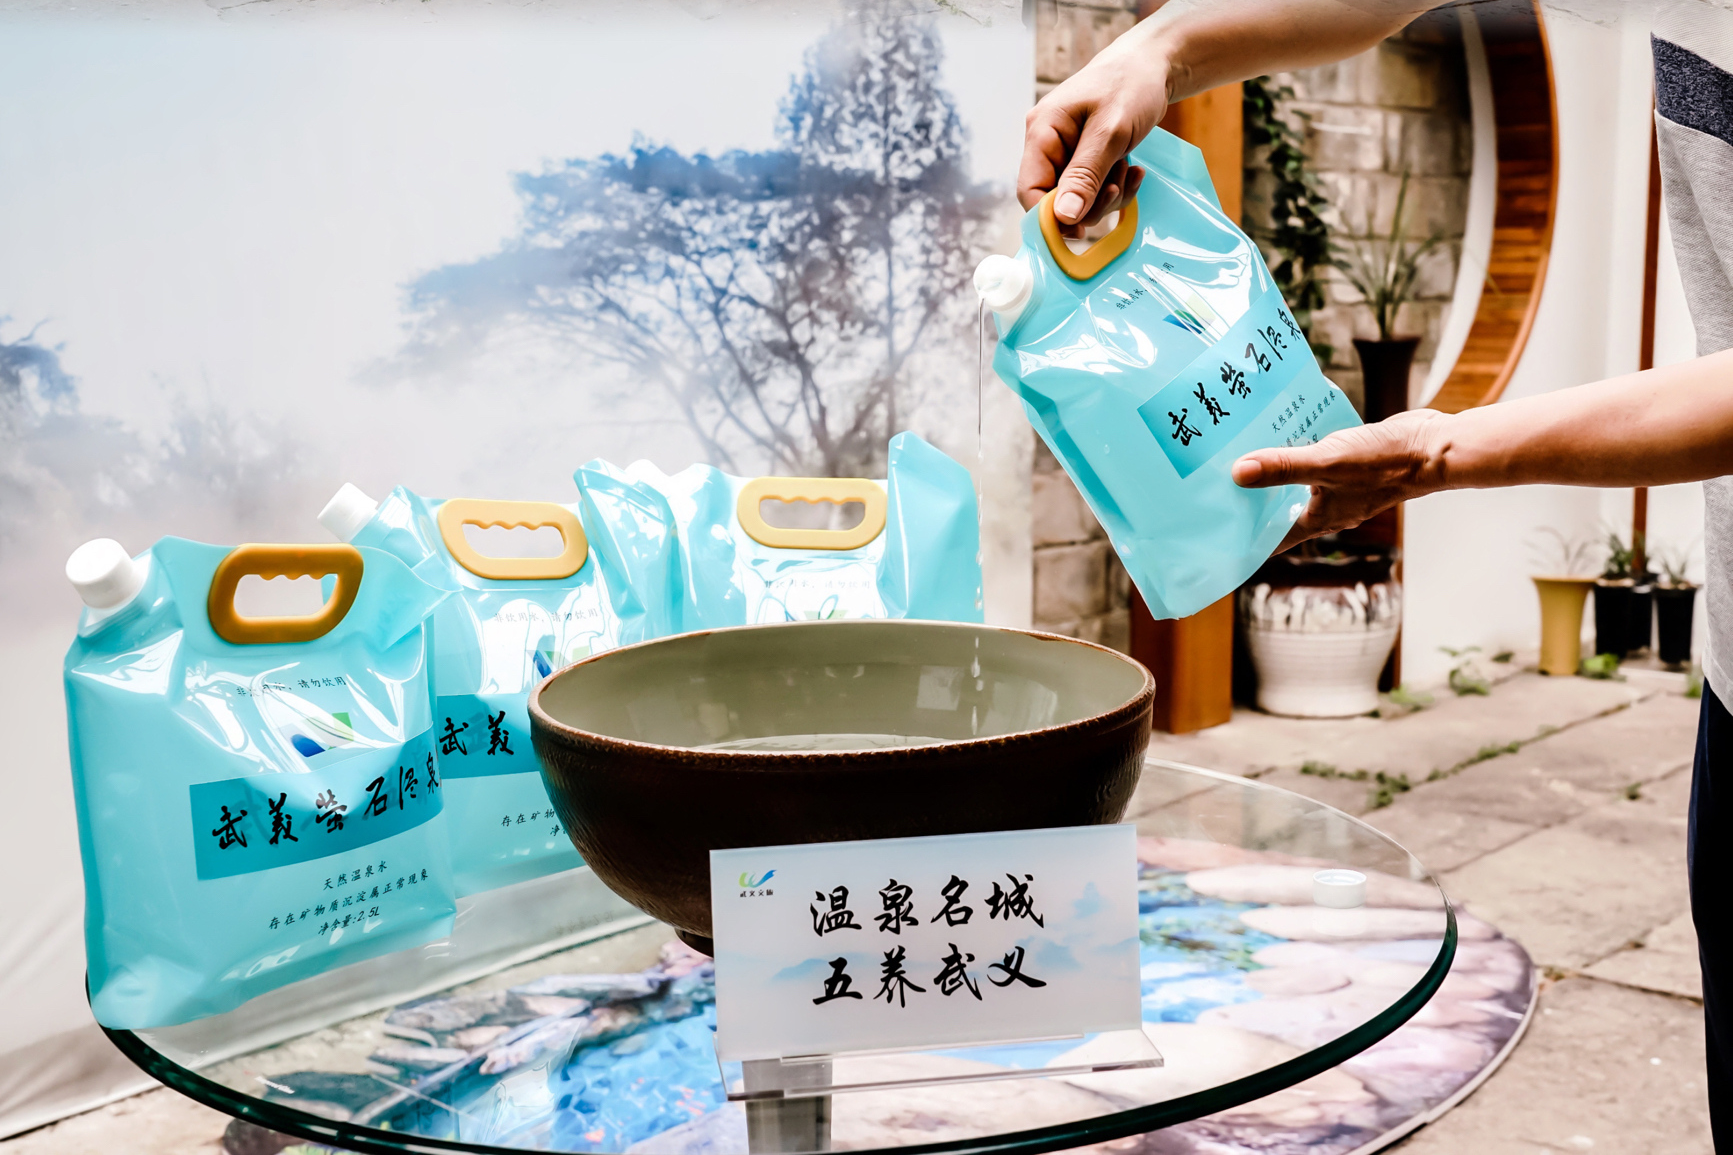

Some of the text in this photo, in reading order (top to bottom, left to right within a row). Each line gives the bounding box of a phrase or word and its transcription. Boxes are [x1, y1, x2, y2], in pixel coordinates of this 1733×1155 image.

[1272, 394, 1305, 433] 天然温泉水
[1281, 390, 1335, 448] 质沉淀属正常现象
[269, 868, 429, 930] 存在矿物质沉淀属正常现象
[323, 861, 388, 891] 天然温泉水
[810, 873, 1045, 937] 温泉名城
[812, 942, 1047, 1008] 五养武义
